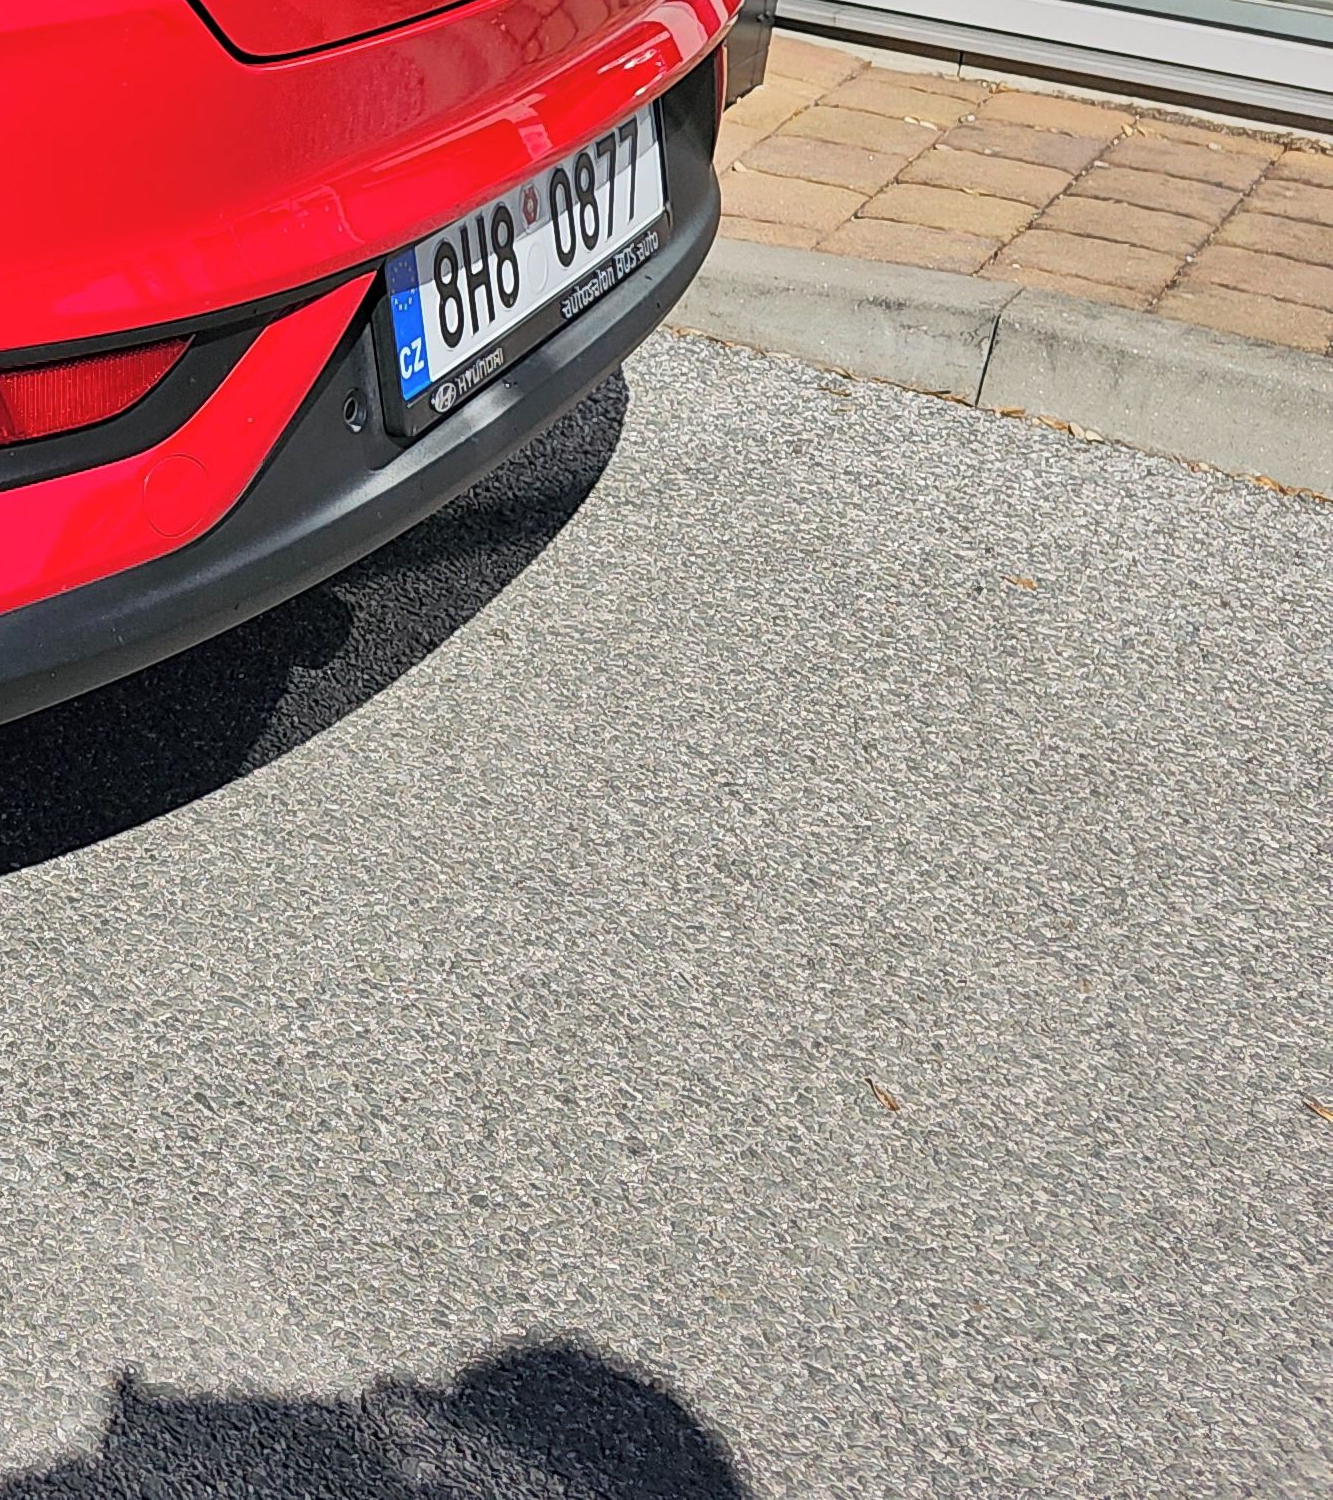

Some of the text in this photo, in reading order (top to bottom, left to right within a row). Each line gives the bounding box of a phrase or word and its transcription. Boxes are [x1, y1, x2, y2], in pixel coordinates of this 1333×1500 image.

[434, 116, 638, 349] 8H8 0877
[562, 231, 659, 319] autosalon BOS auto
[399, 337, 425, 380] CZ
[455, 347, 504, 395] HYUNDAI
